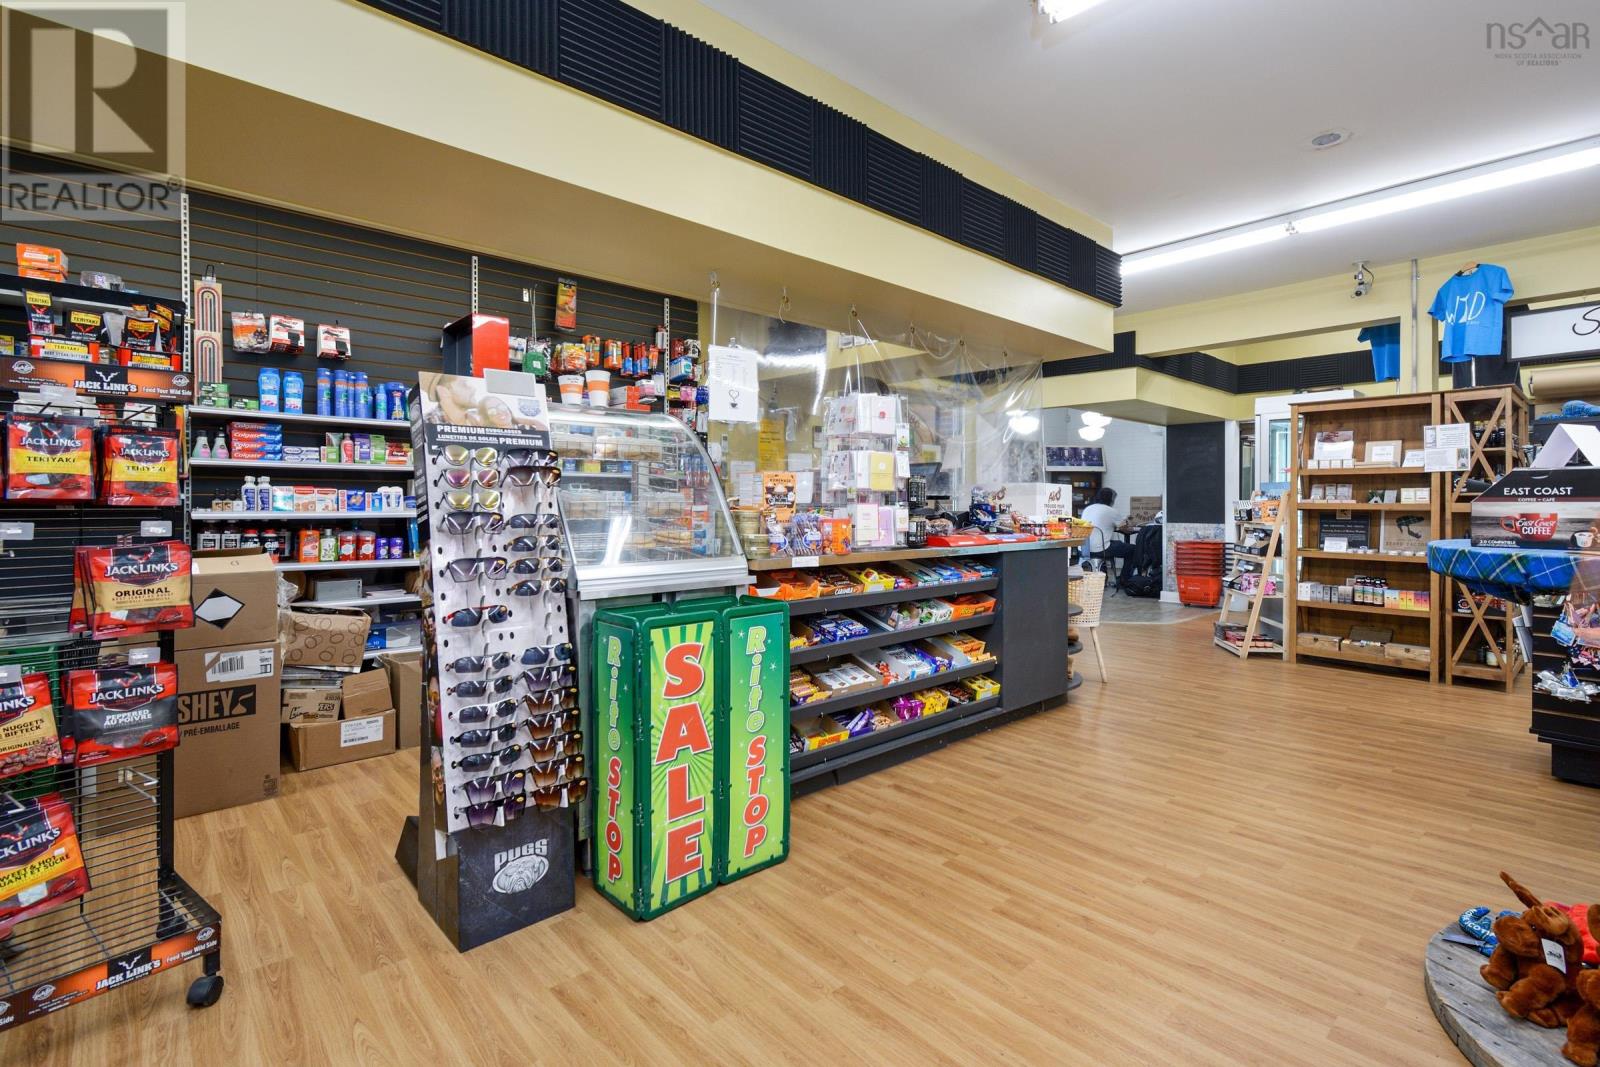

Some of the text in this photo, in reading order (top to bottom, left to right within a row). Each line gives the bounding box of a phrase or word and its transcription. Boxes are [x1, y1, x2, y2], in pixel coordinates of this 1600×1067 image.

[75, 380, 101, 389] JACK
[437, 425, 485, 434] PREMIUM
[20, 437, 49, 447] JACK
[500, 438, 543, 447] PREMIUM
[1504, 487, 1573, 496] EAST COAST
[1522, 526, 1551, 535] COFFEE
[104, 564, 138, 578] JACK
[115, 587, 171, 598] ORIGINAL
[746, 626, 767, 733] Rite
[89, 690, 124, 704] JACK
[105, 709, 150, 721] PEPPERED
[118, 713, 152, 724] POIVRE
[3, 718, 45, 732] NUGGETS
[5, 725, 41, 737] BIFTECK
[655, 642, 713, 884] SALE
[743, 735, 769, 857] STOP
[604, 757, 622, 884] STOP
[494, 838, 549, 873] PUGS
[96, 959, 161, 990] JACK LINK'S
